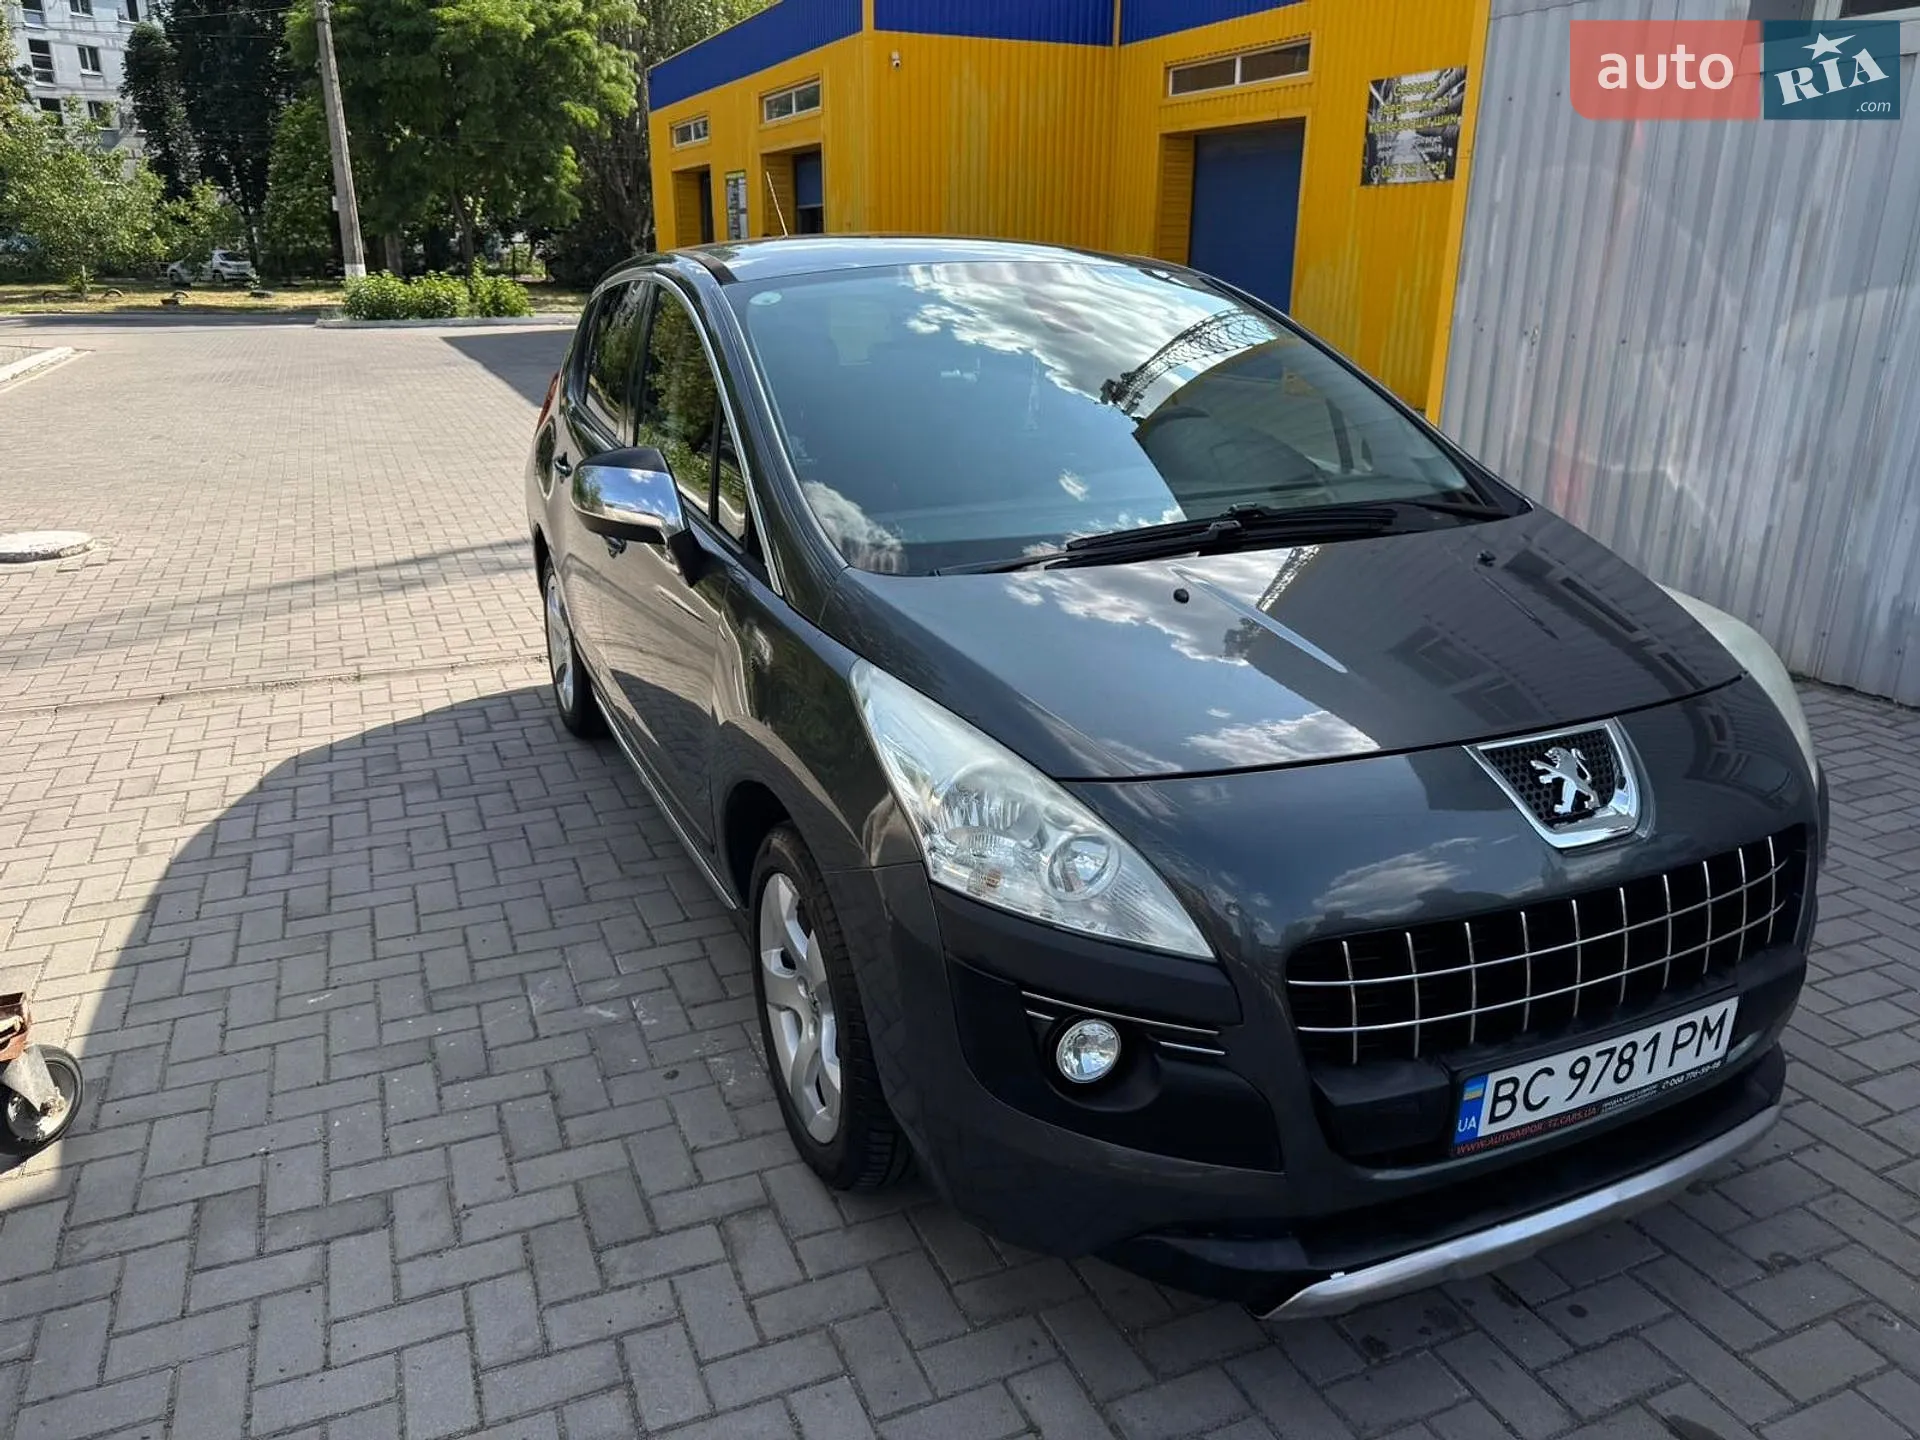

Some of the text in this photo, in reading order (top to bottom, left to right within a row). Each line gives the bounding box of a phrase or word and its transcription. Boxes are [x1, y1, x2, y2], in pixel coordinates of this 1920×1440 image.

[1488, 1067, 1555, 1125] BC
[1565, 1031, 1662, 1102] 9781
[1668, 1007, 1729, 1067] PM
[1457, 1116, 1477, 1132] UA
